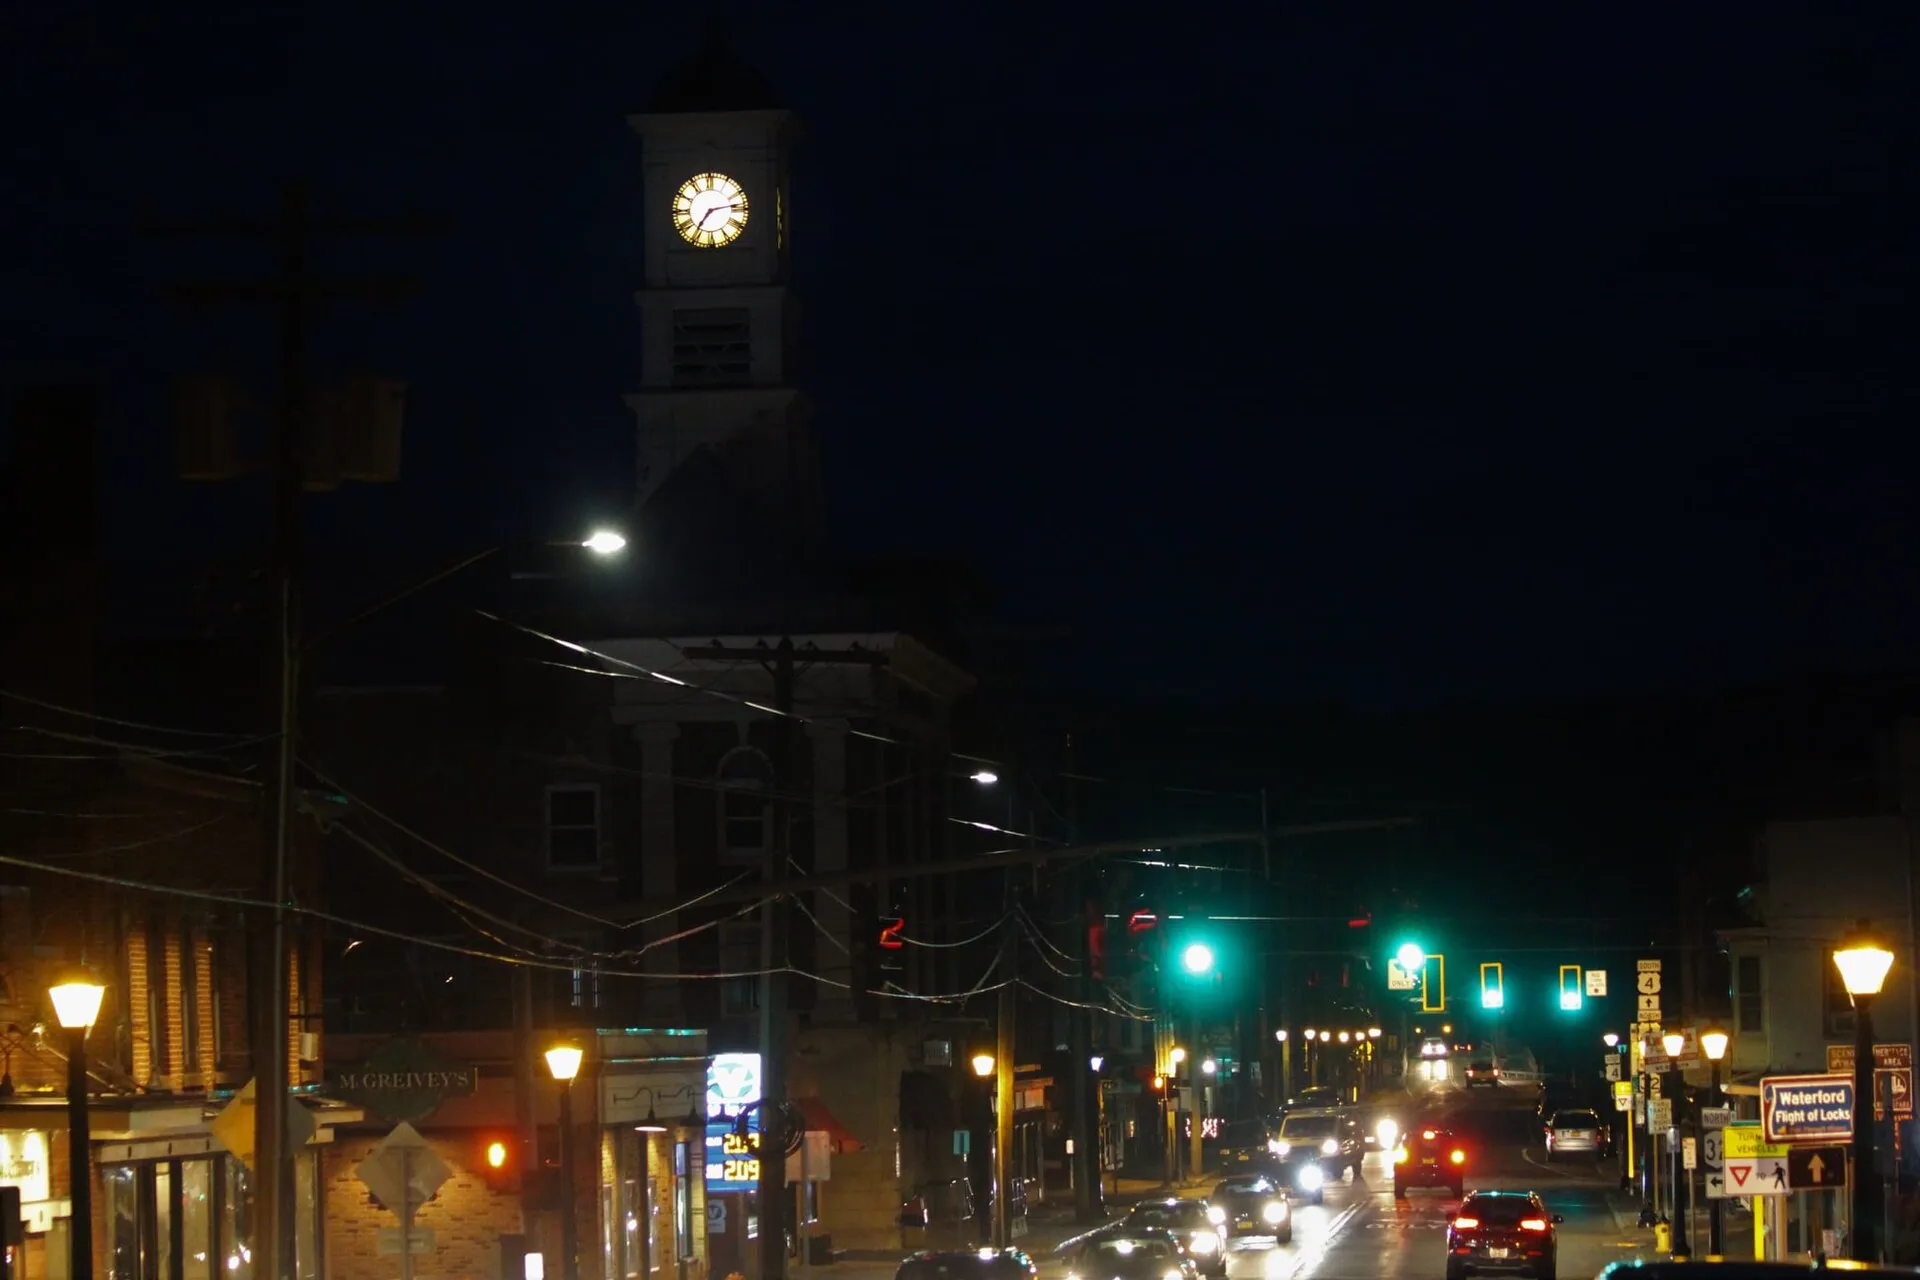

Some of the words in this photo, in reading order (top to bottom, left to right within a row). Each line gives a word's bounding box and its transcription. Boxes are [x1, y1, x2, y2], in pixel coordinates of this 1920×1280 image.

[1644, 977, 1654, 989] 4
[1779, 1089, 1846, 1106] Waterford
[1704, 1113, 1730, 1124] NORTH
[1775, 1109, 1805, 1126] Flight
[1807, 1108, 1819, 1122] of
[1820, 1107, 1851, 1122] Locks
[1737, 1131, 1761, 1141] TURN
[1706, 1139, 1722, 1161] 3
[1737, 1144, 1779, 1154] VEHICLES
[724, 1159, 760, 1181] 209
